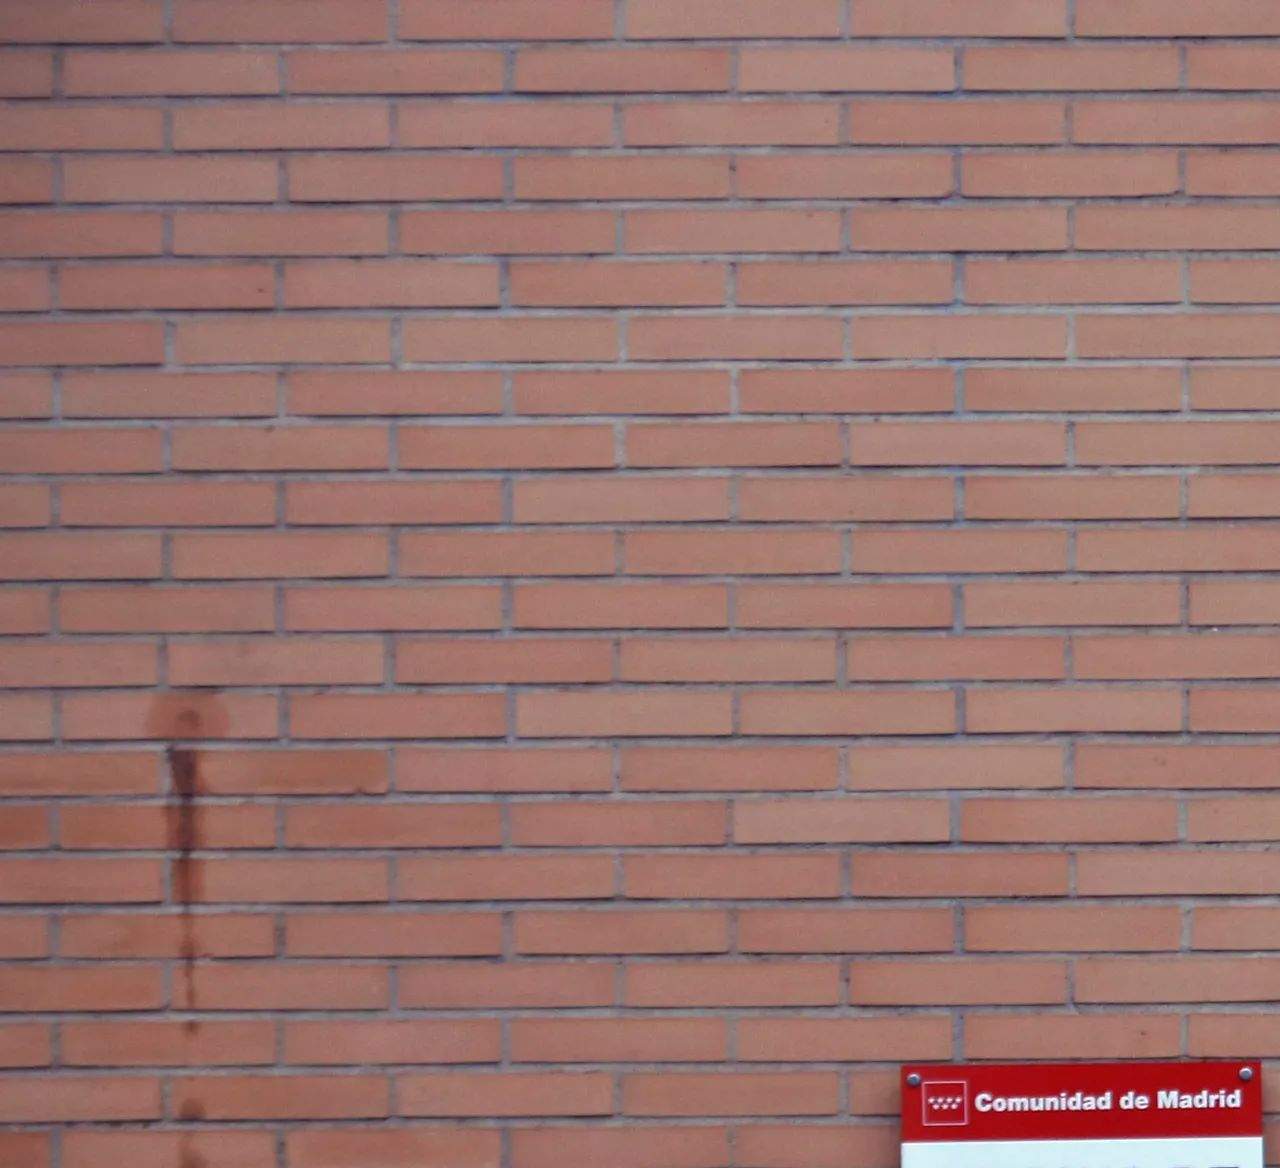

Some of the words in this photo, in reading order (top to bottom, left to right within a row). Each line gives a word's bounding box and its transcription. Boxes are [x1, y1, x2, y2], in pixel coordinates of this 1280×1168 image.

[975, 1091, 1112, 1112] Comunidad
[1119, 1091, 1149, 1110] de
[1157, 1089, 1241, 1109] Madrid
